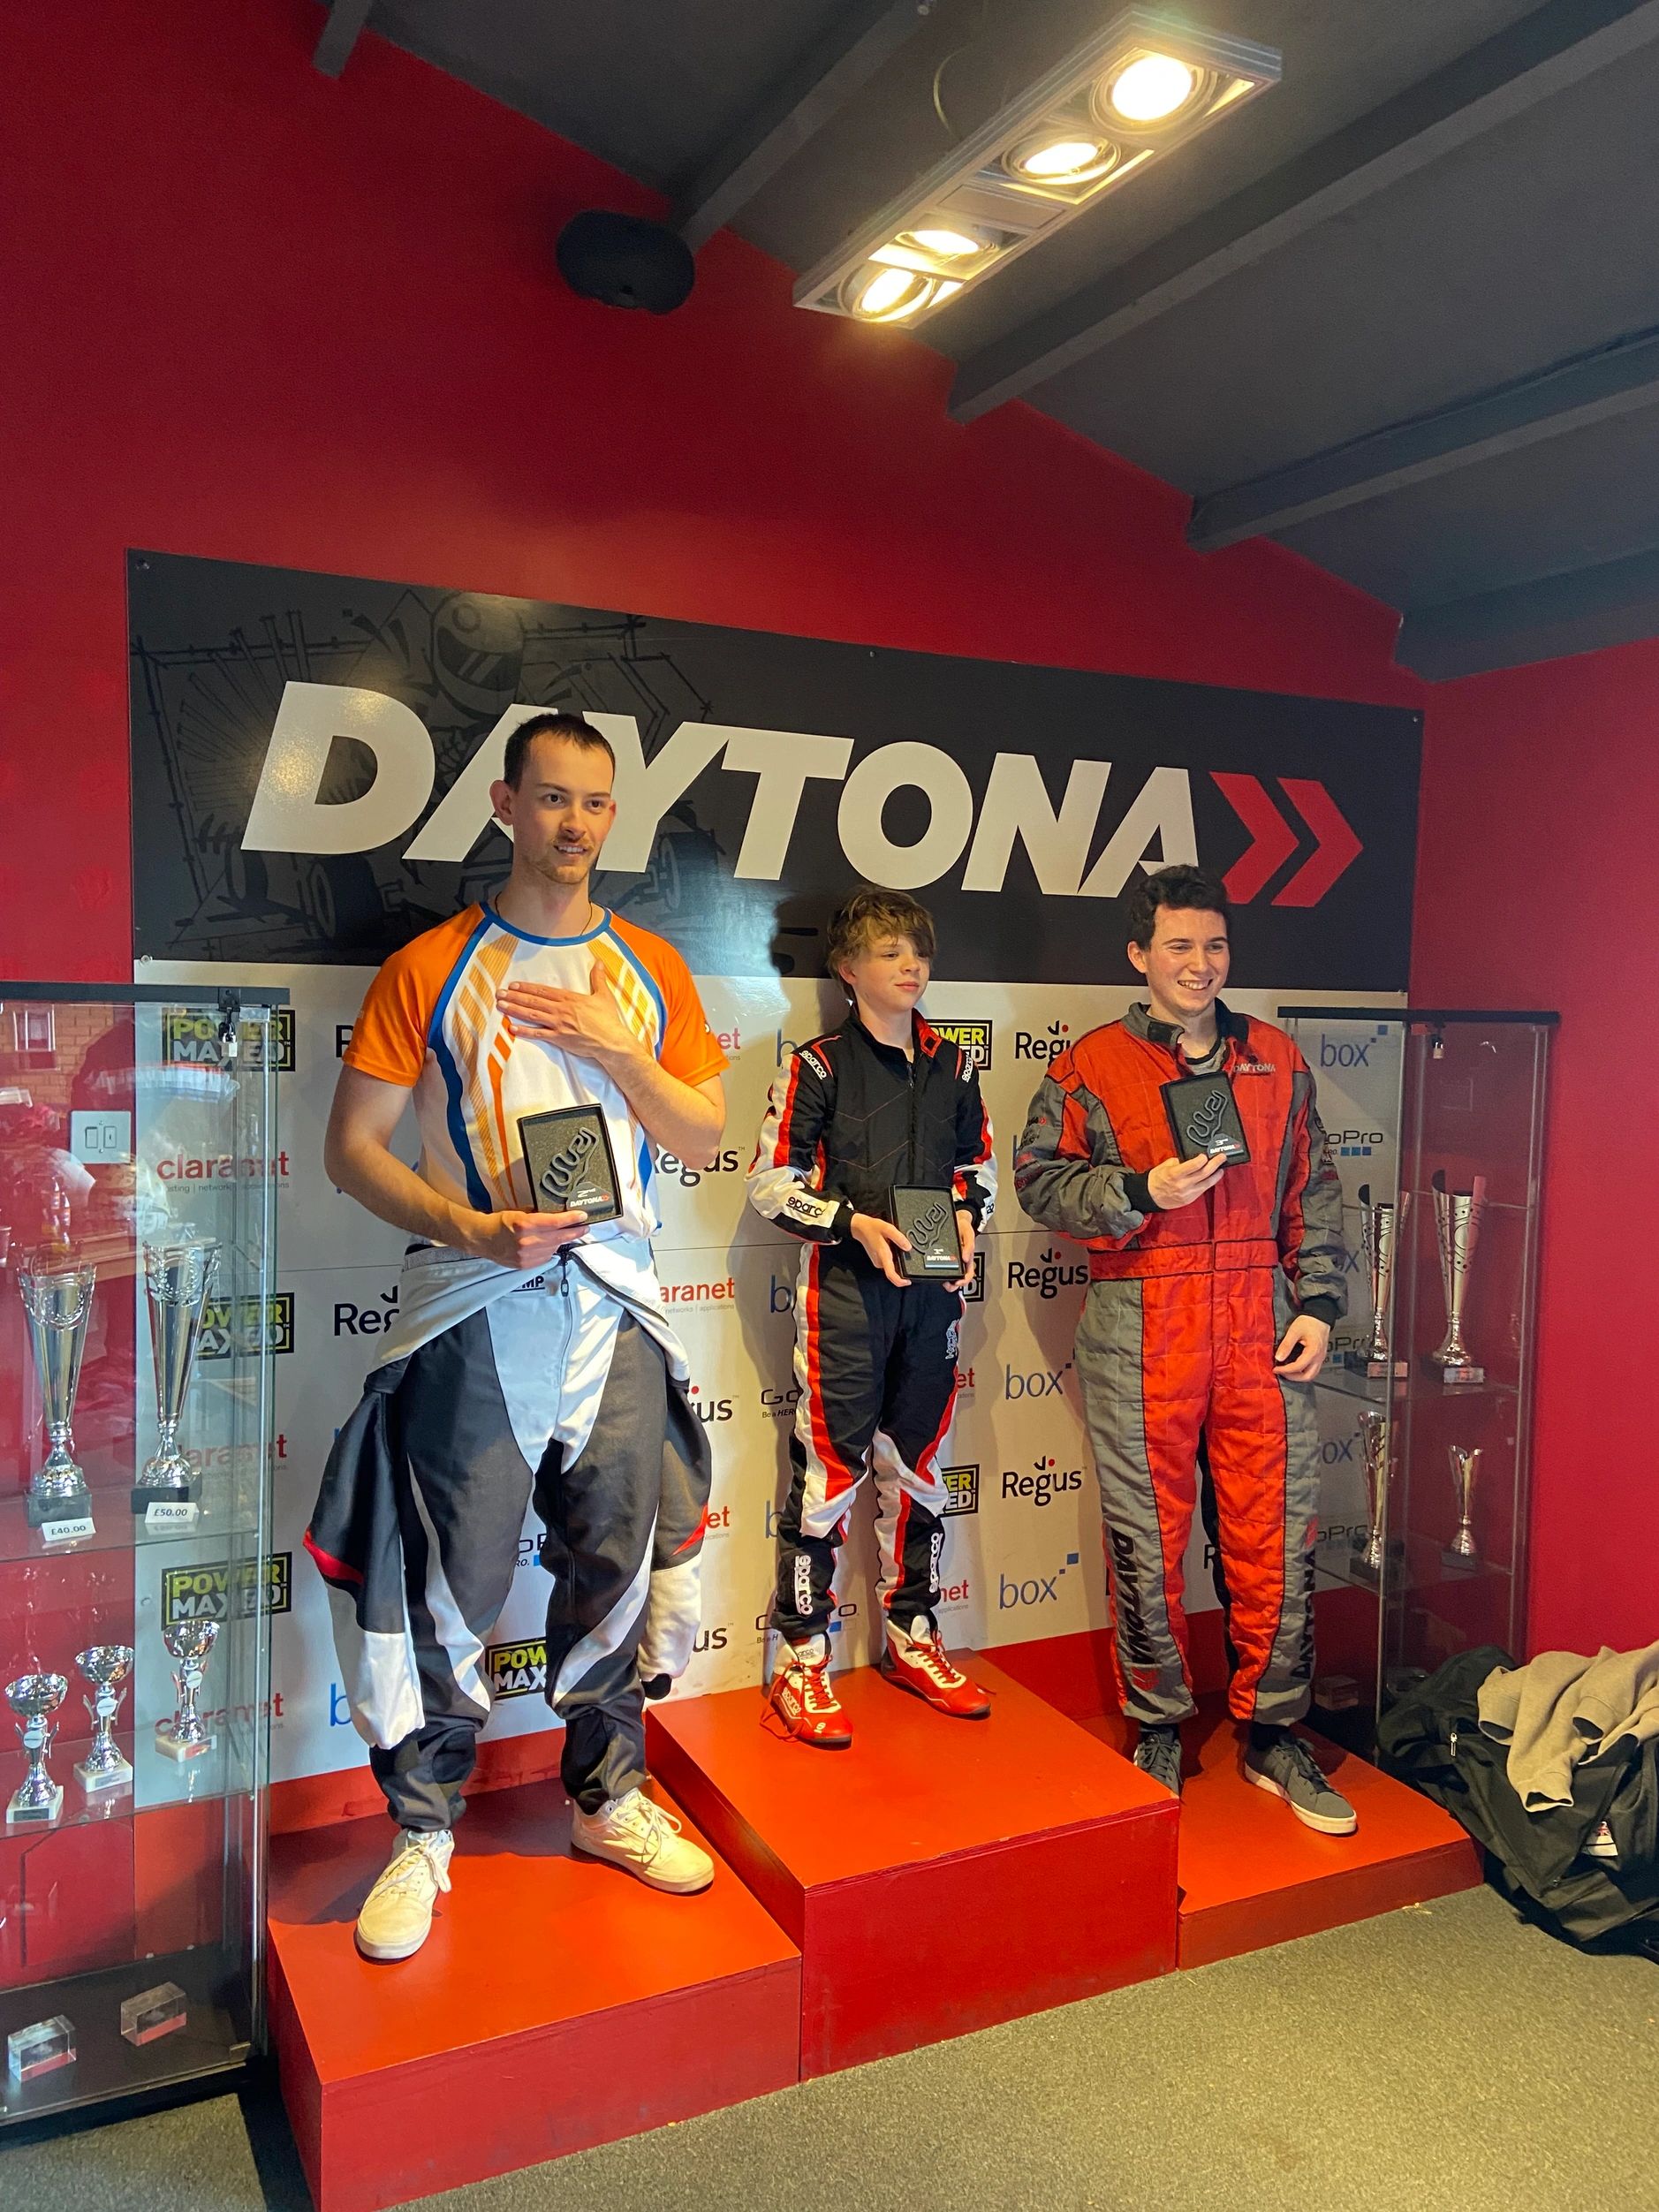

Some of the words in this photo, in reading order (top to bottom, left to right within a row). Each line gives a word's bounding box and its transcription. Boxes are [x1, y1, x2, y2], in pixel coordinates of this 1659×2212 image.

[935, 1027, 985, 1045] WER
[1321, 1034, 1370, 1067] box
[799, 1049, 827, 1079] sparco
[1328, 1130, 1383, 1145] oPro
[570, 1196, 603, 1208] DAYTONA
[1008, 1261, 1089, 1299] Regus
[1005, 1364, 1063, 1400] box
[1002, 1470, 1082, 1507] Regus
[154, 1508, 188, 1517] £50.00
[50, 1525, 87, 1535] £40.00
[794, 1555, 814, 1616] sparco
[999, 1573, 1057, 1610] box
